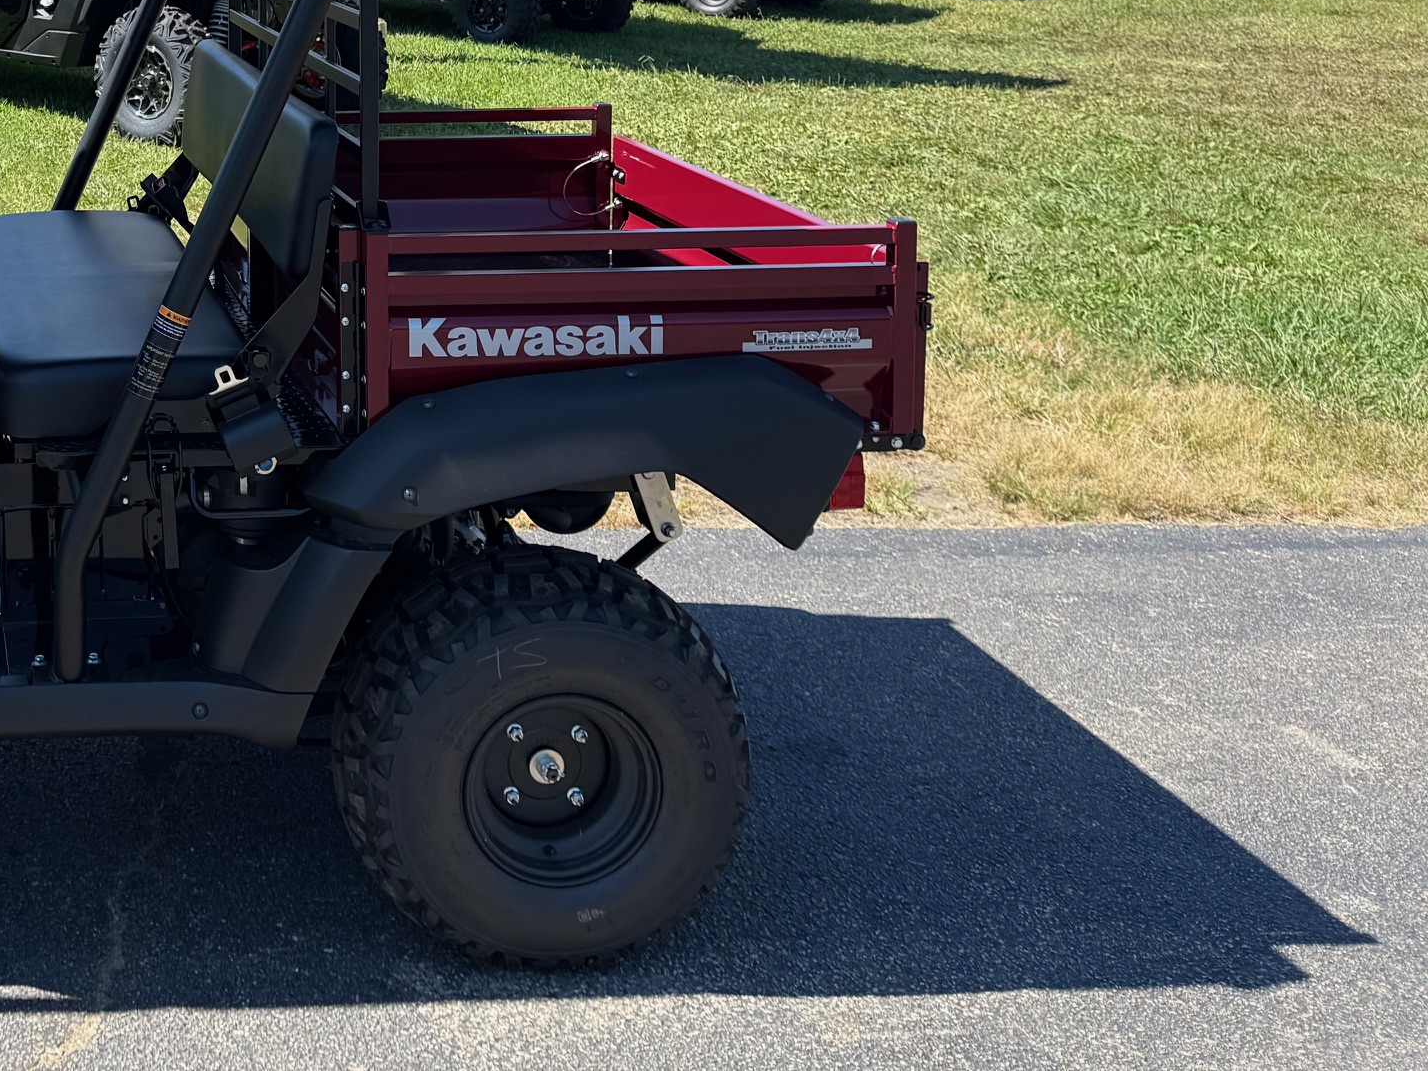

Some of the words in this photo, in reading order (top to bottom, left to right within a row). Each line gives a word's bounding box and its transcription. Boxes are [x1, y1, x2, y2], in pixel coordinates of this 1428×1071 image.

[408, 315, 664, 358] Kawasaki
[753, 328, 860, 345] Trans4x4
[653, 674, 718, 784] DURO
